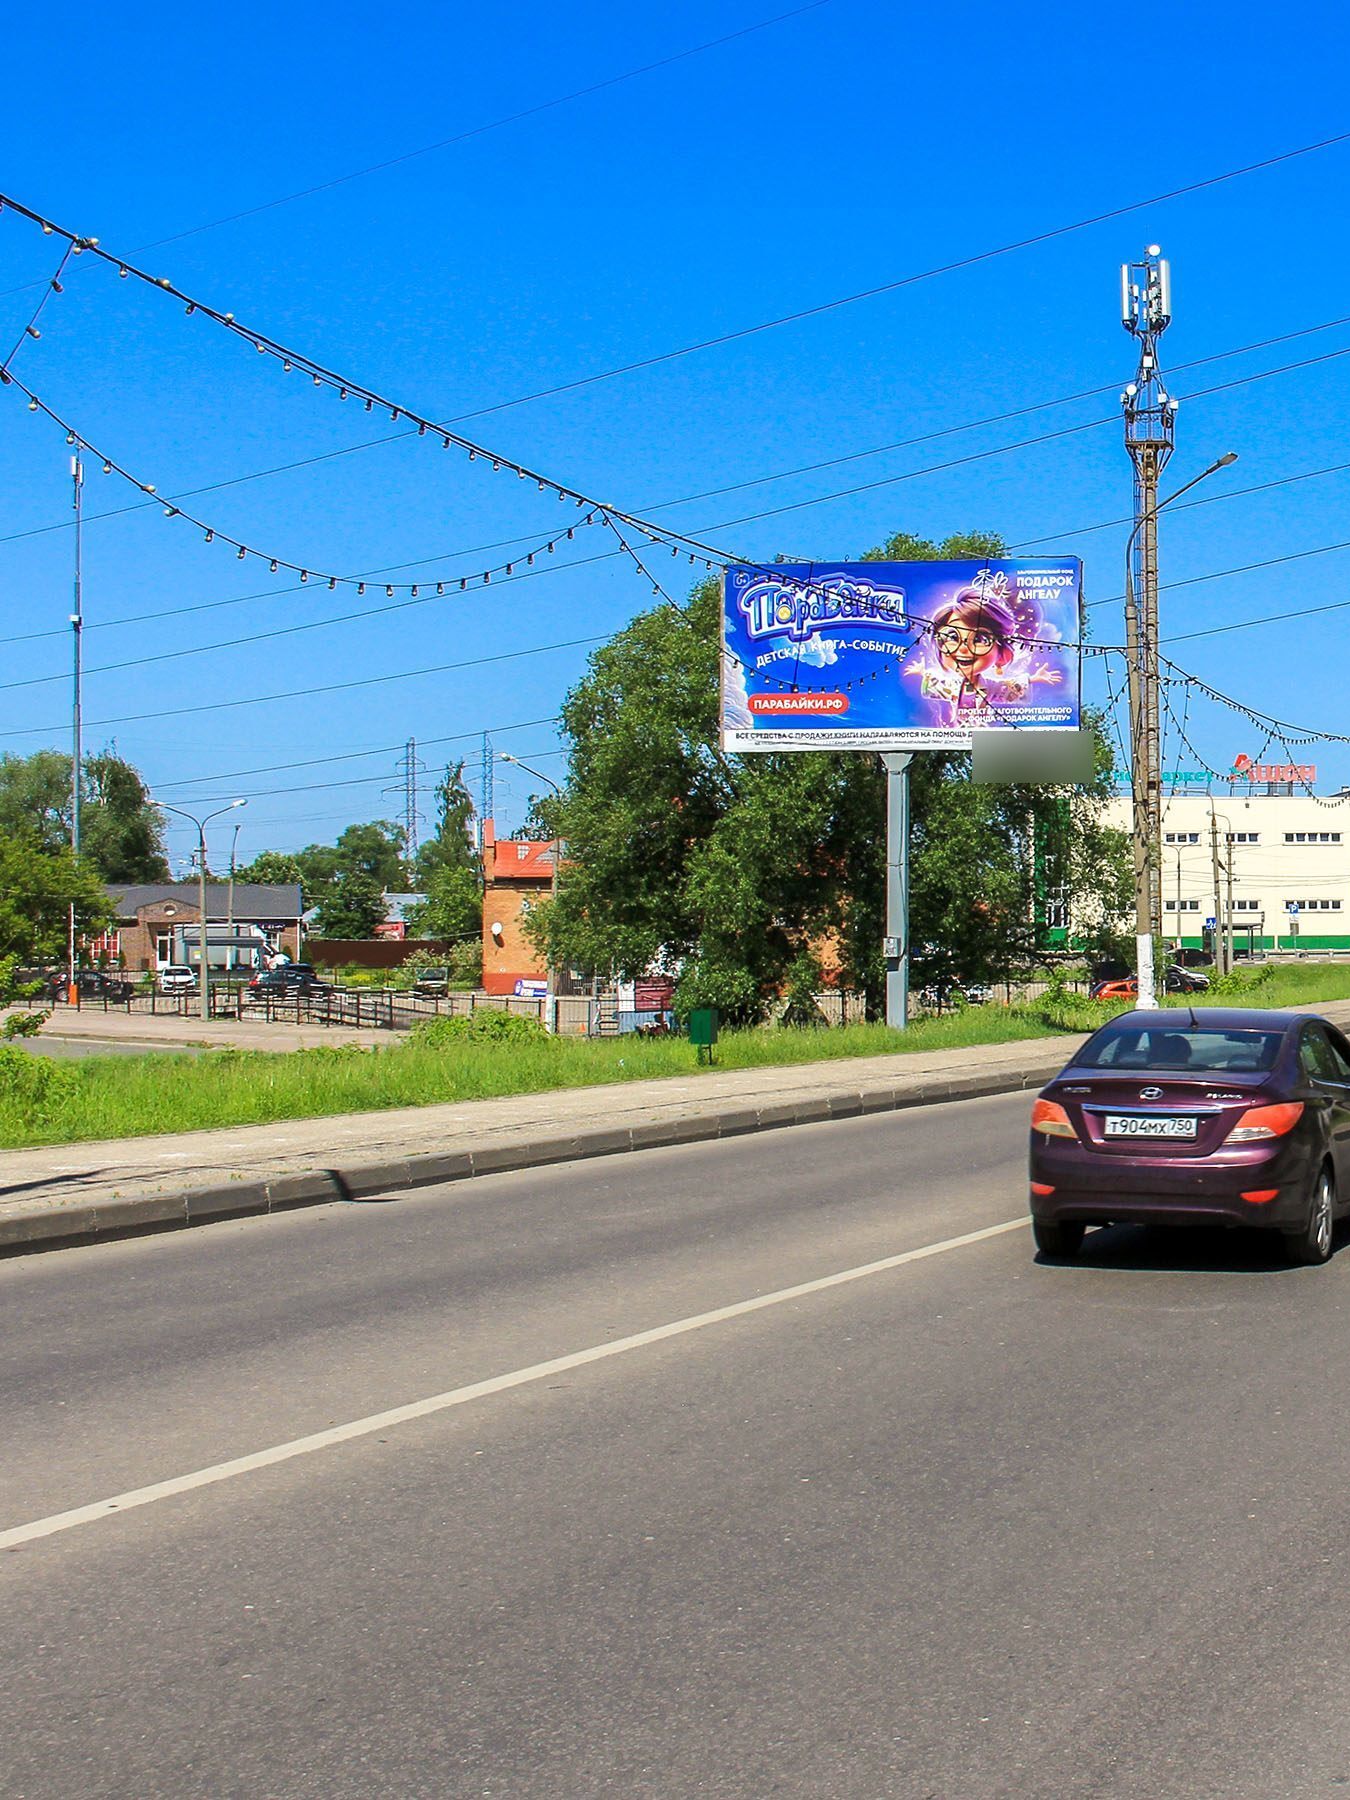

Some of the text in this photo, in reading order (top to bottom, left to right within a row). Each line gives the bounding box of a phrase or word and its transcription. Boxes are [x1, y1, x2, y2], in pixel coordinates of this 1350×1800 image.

[1016, 576, 1074, 587] ПОДАРОК
[1017, 588, 1061, 600] АНГЕЛУ
[756, 643, 807, 668] ДЕТСКАЯ
[753, 696, 843, 710] ПАРАБАЙКИ.РФ
[735, 732, 749, 740] ВСЕ
[750, 732, 787, 740] СРЕДСТВА
[933, 730, 967, 738] ПОМОЩЬ
[1170, 1119, 1192, 1131] 750
